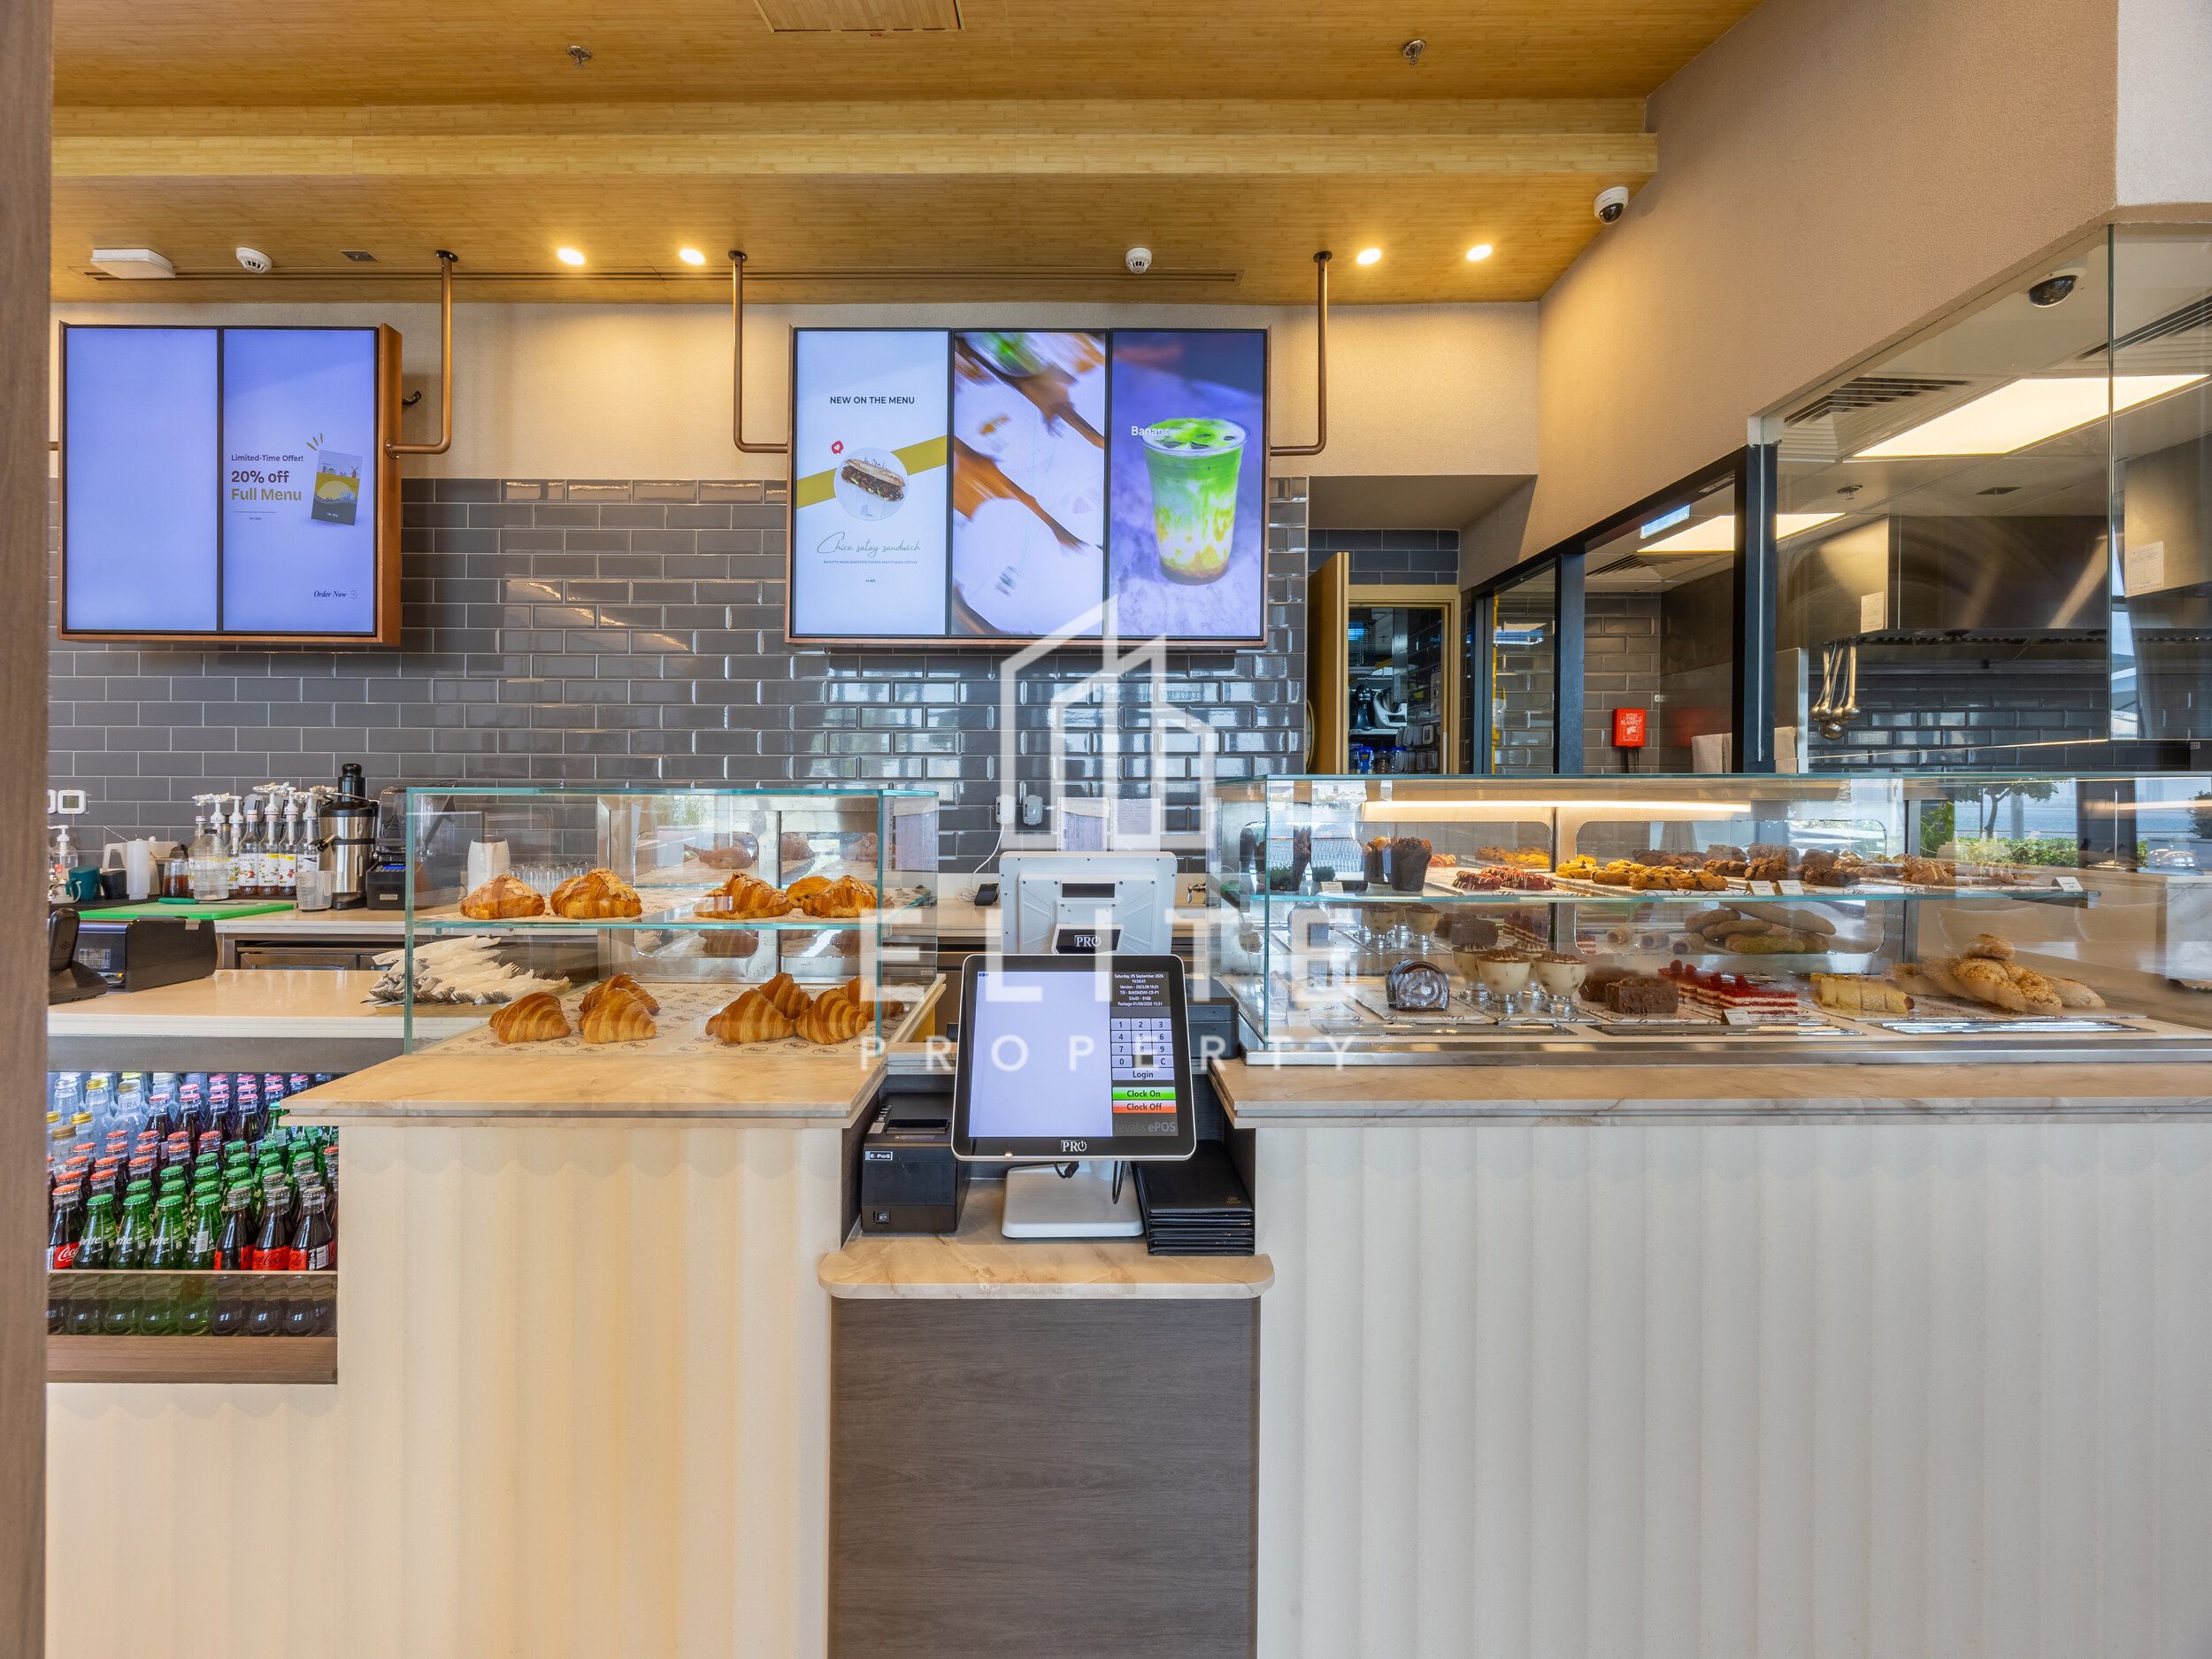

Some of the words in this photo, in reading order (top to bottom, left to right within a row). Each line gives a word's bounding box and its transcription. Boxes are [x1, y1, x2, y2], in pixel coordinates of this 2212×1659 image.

[231, 470, 265, 484] 20%
[268, 470, 290, 483] off
[231, 488, 257, 501] Full
[261, 488, 302, 501] Menu
[1133, 1071, 1154, 1079] Login
[1148, 1121, 1176, 1133] ePOS
